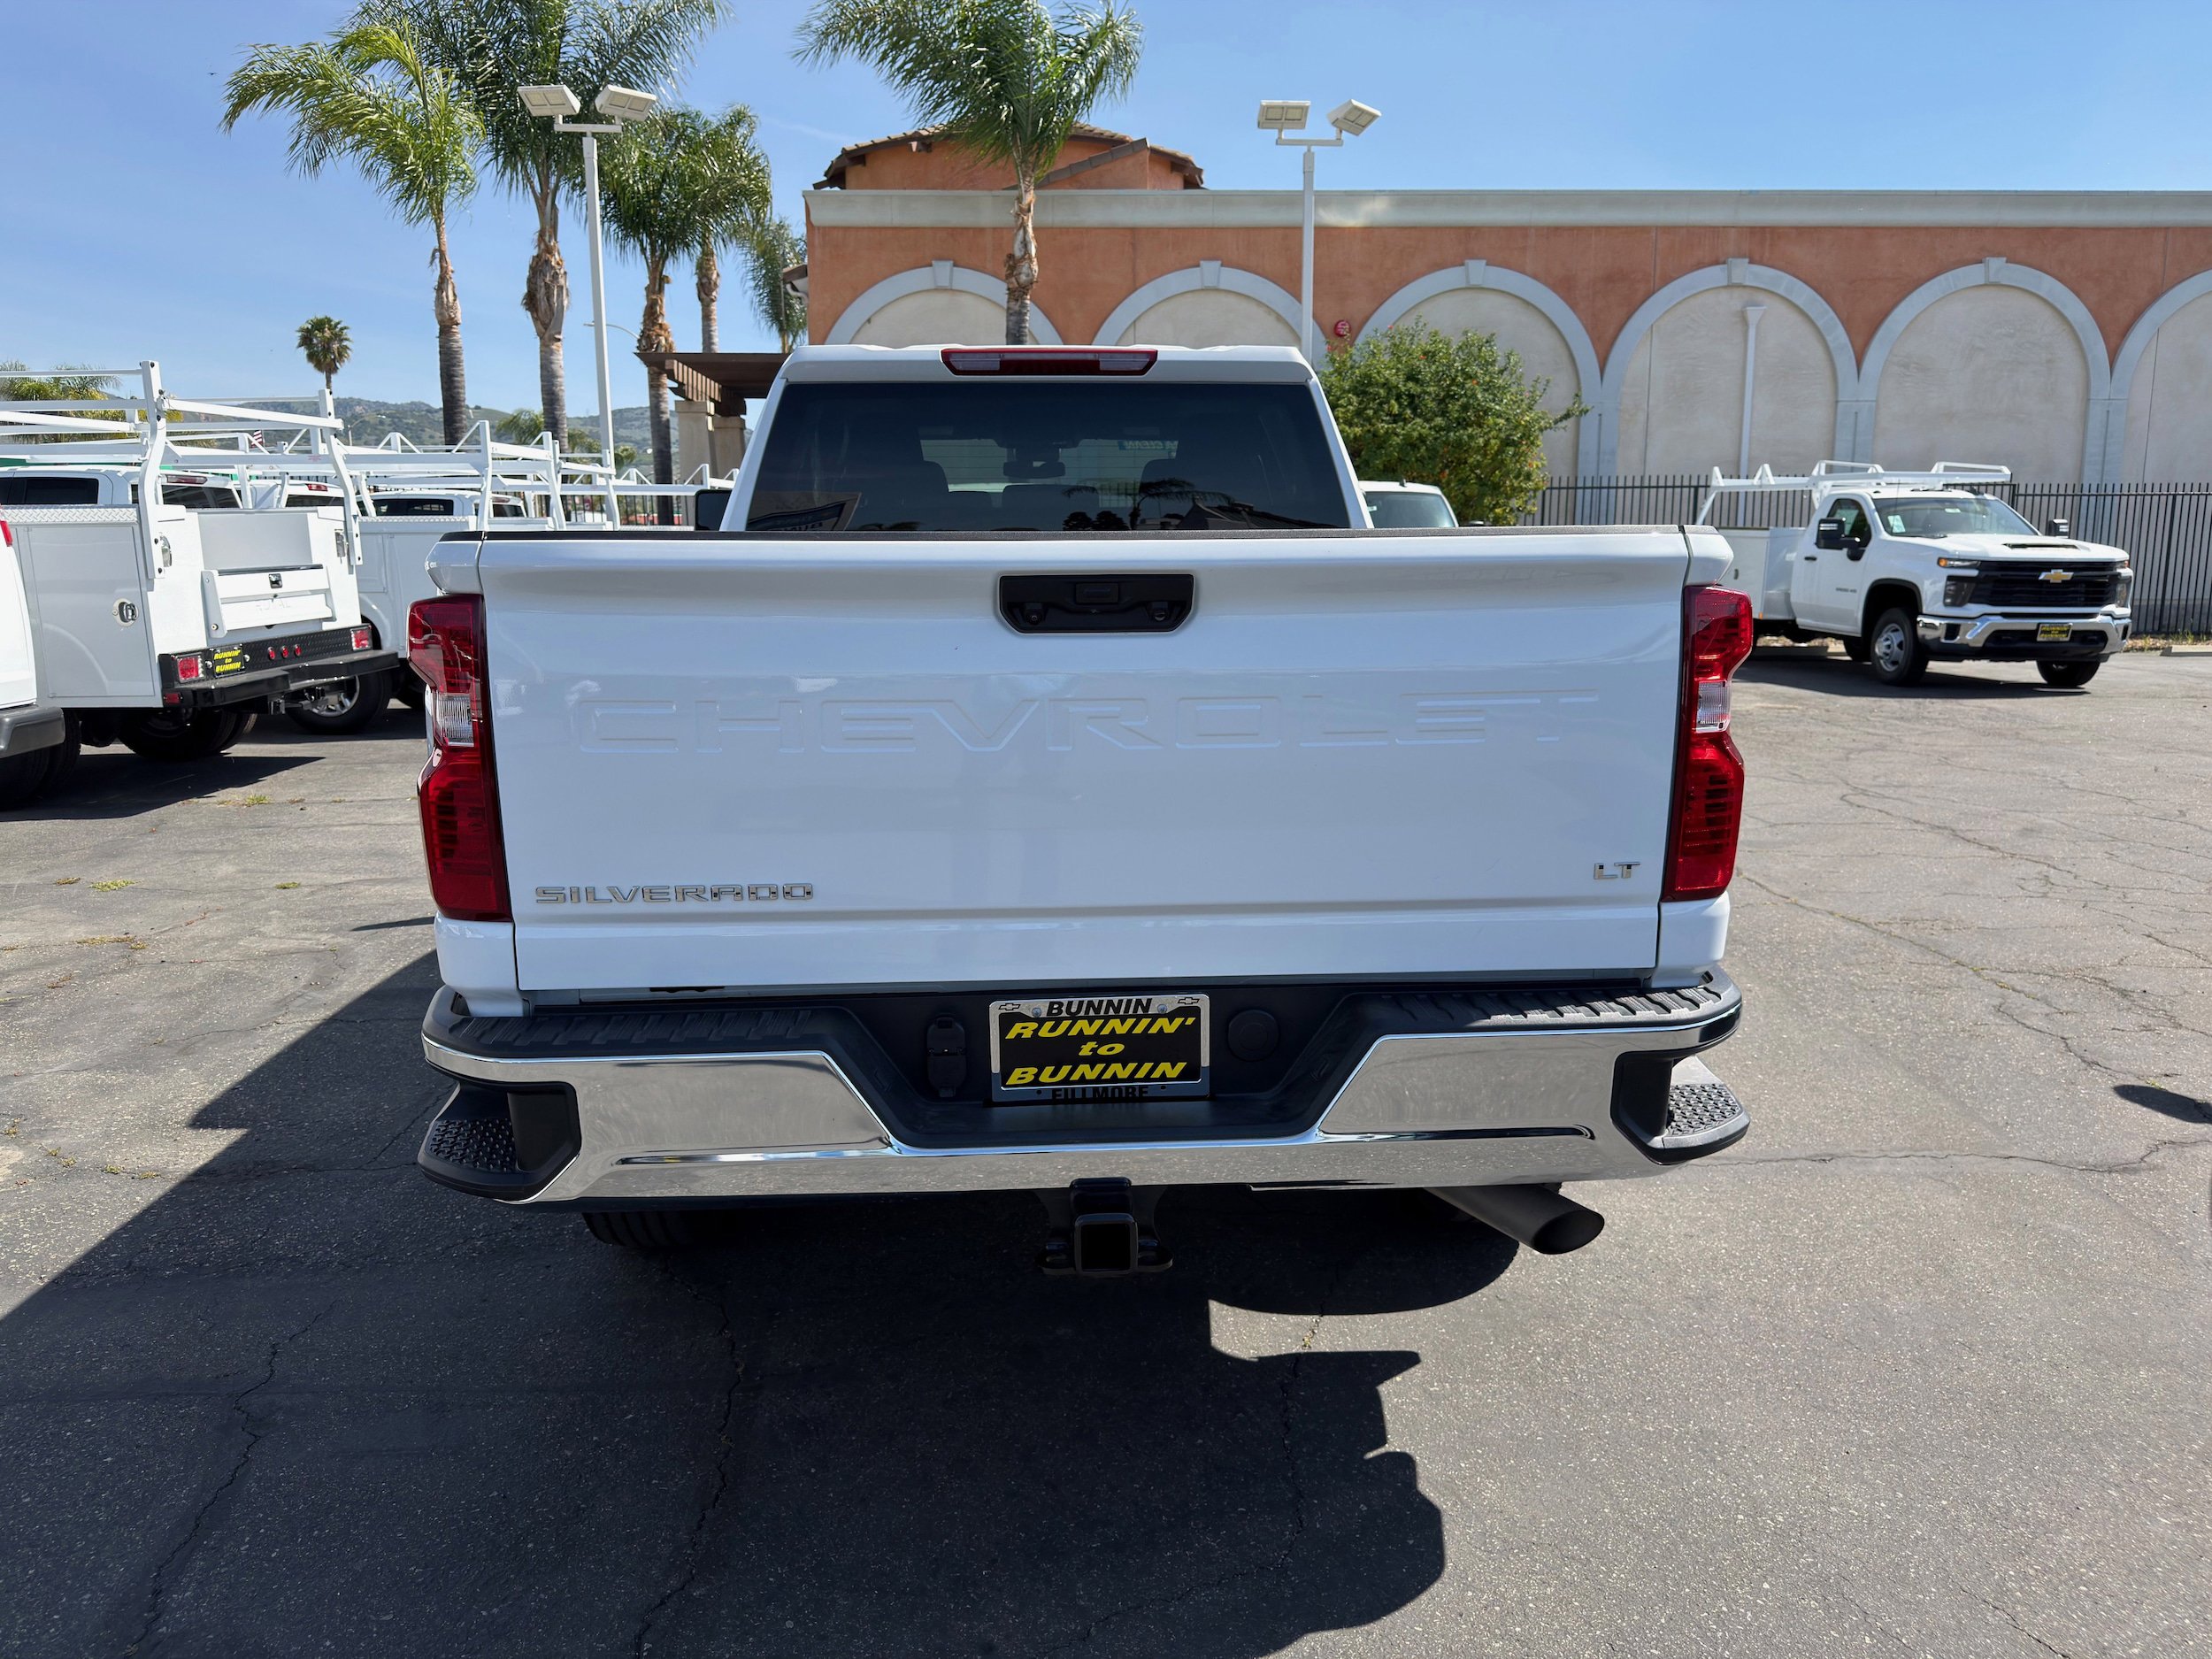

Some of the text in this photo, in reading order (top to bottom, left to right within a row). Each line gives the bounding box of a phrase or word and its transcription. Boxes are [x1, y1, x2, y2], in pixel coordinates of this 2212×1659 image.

[578, 688, 1601, 754] CHEVROLET
[1594, 861, 1641, 880] LT
[535, 883, 813, 903] SILVERADO
[1047, 997, 1153, 1017] BUNNIN
[1005, 1017, 1196, 1040] RUNNIN'
[1078, 1041, 1125, 1056] to
[1005, 1062, 1187, 1086] BUNNIN
[1051, 1085, 1149, 1100] FILLMORE
